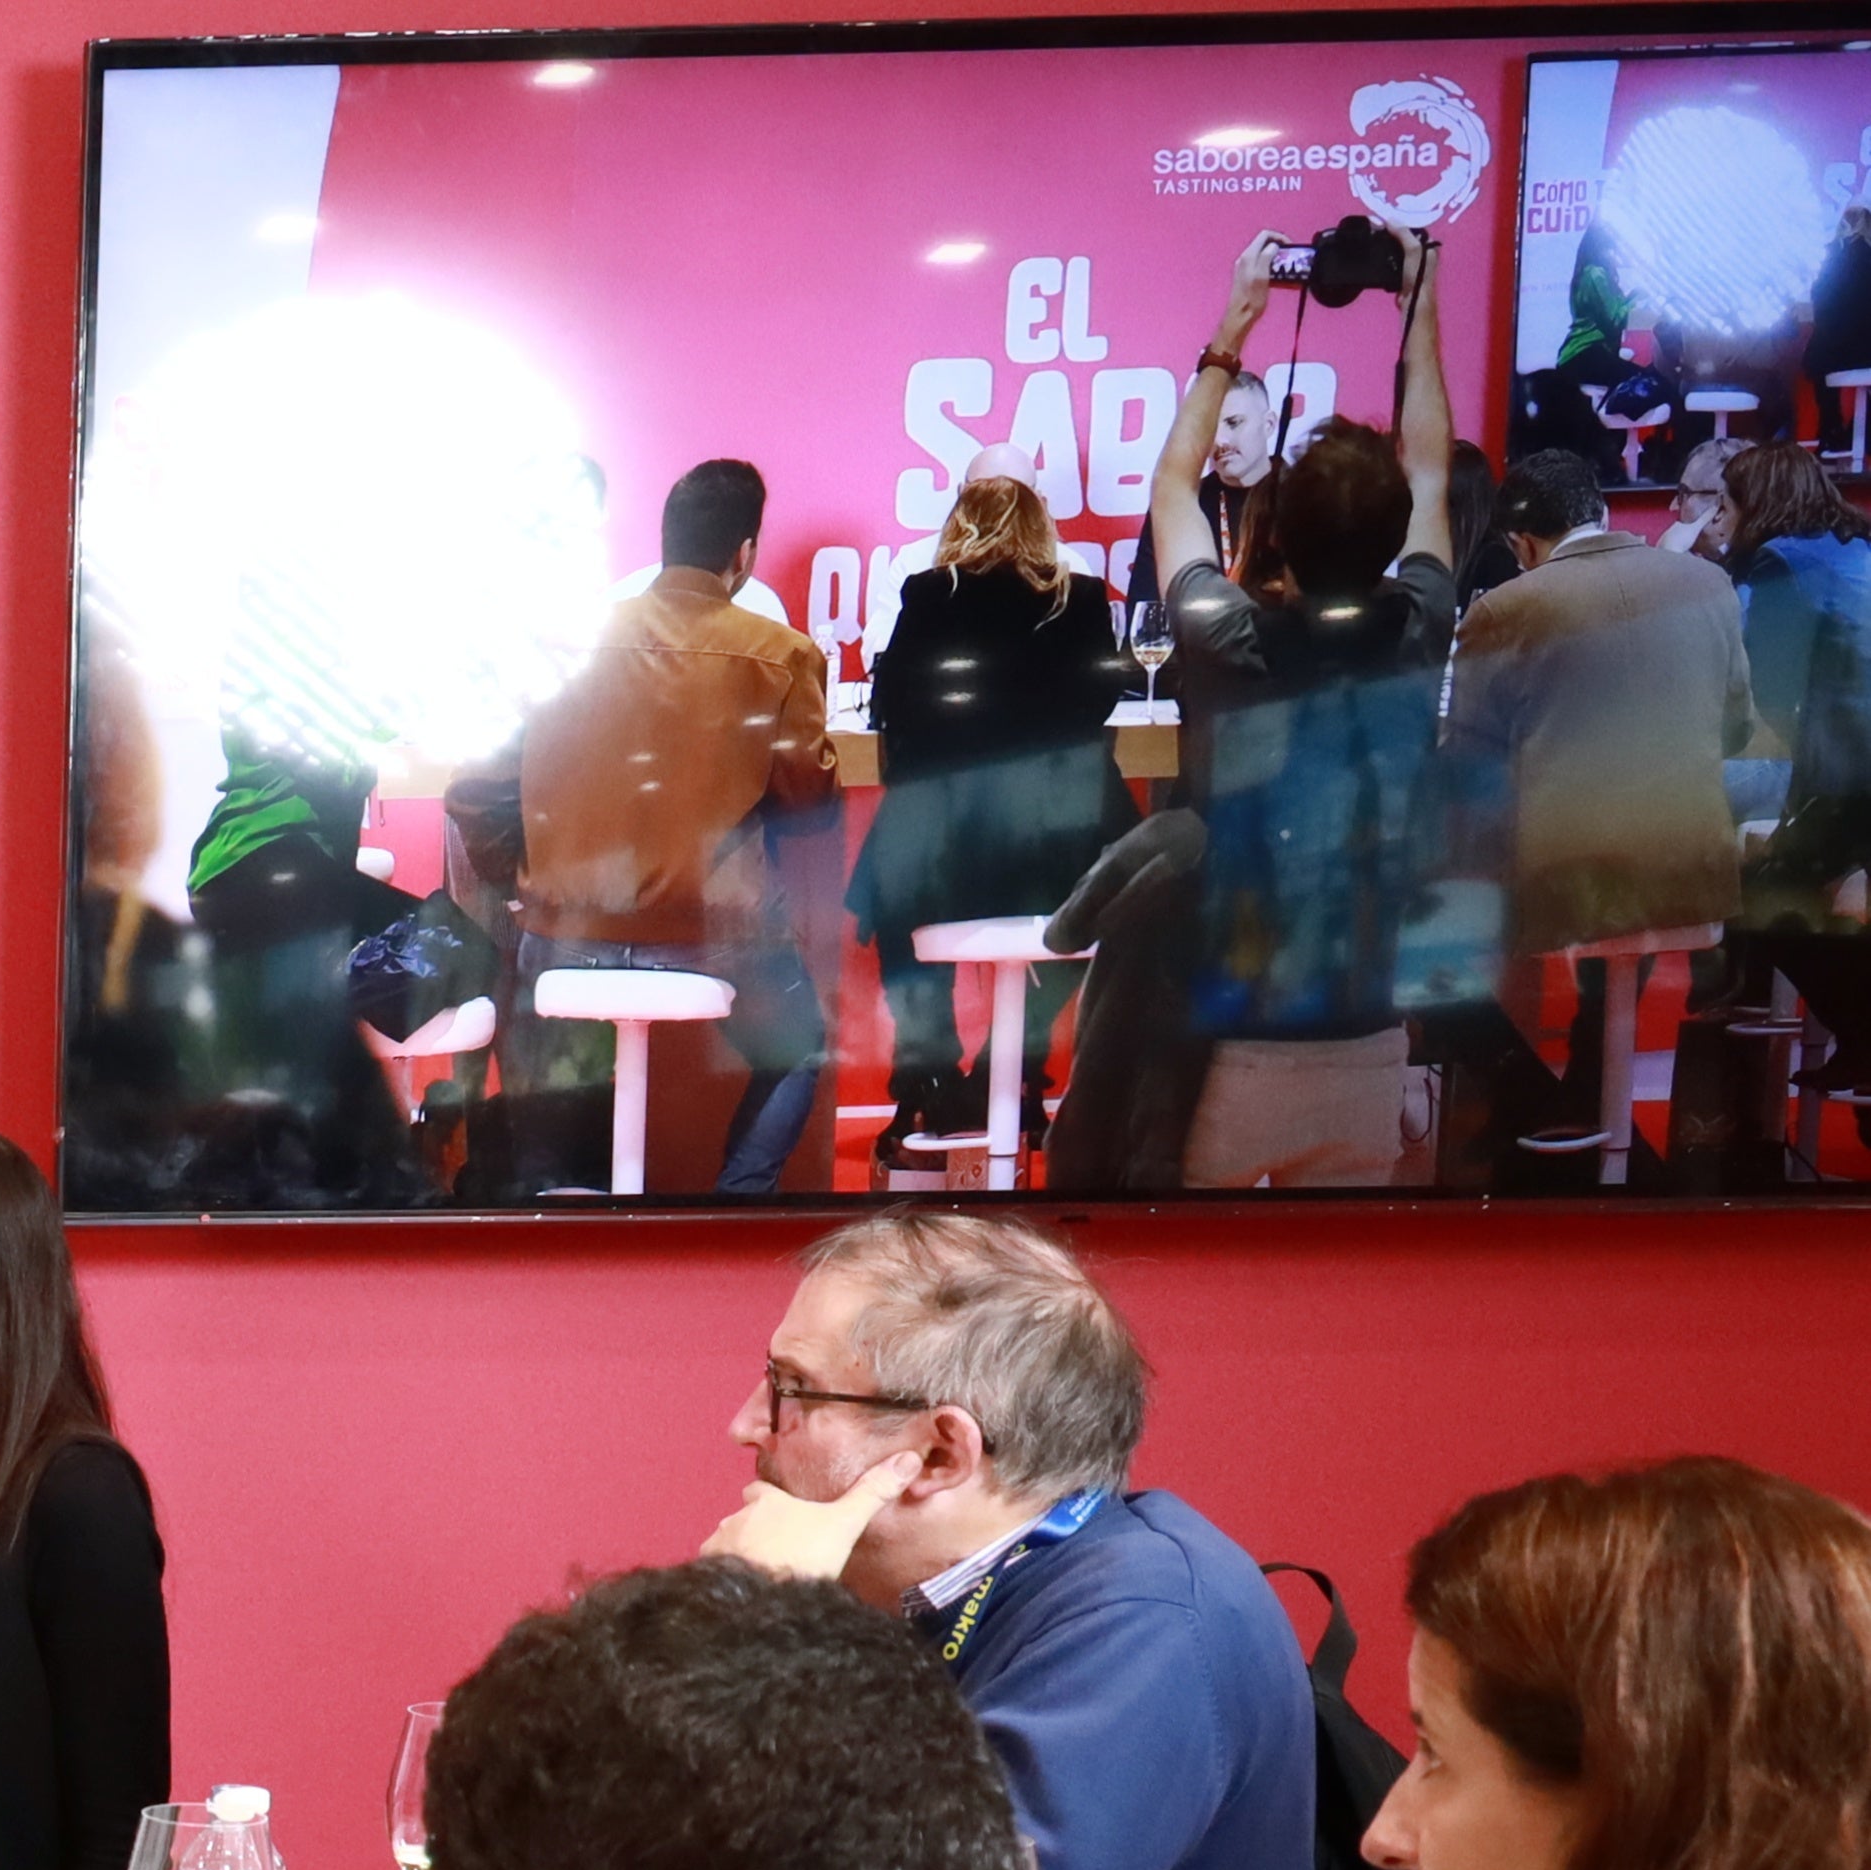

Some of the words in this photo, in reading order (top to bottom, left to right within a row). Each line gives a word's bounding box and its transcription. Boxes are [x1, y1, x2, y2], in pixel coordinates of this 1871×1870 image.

[1153, 133, 1439, 174] saboreaespaña
[1153, 175, 1302, 195] TASTINGSPAIN
[1005, 255, 1109, 364] EL
[895, 356, 1338, 531] SABR
[942, 1575, 994, 1661] makro
